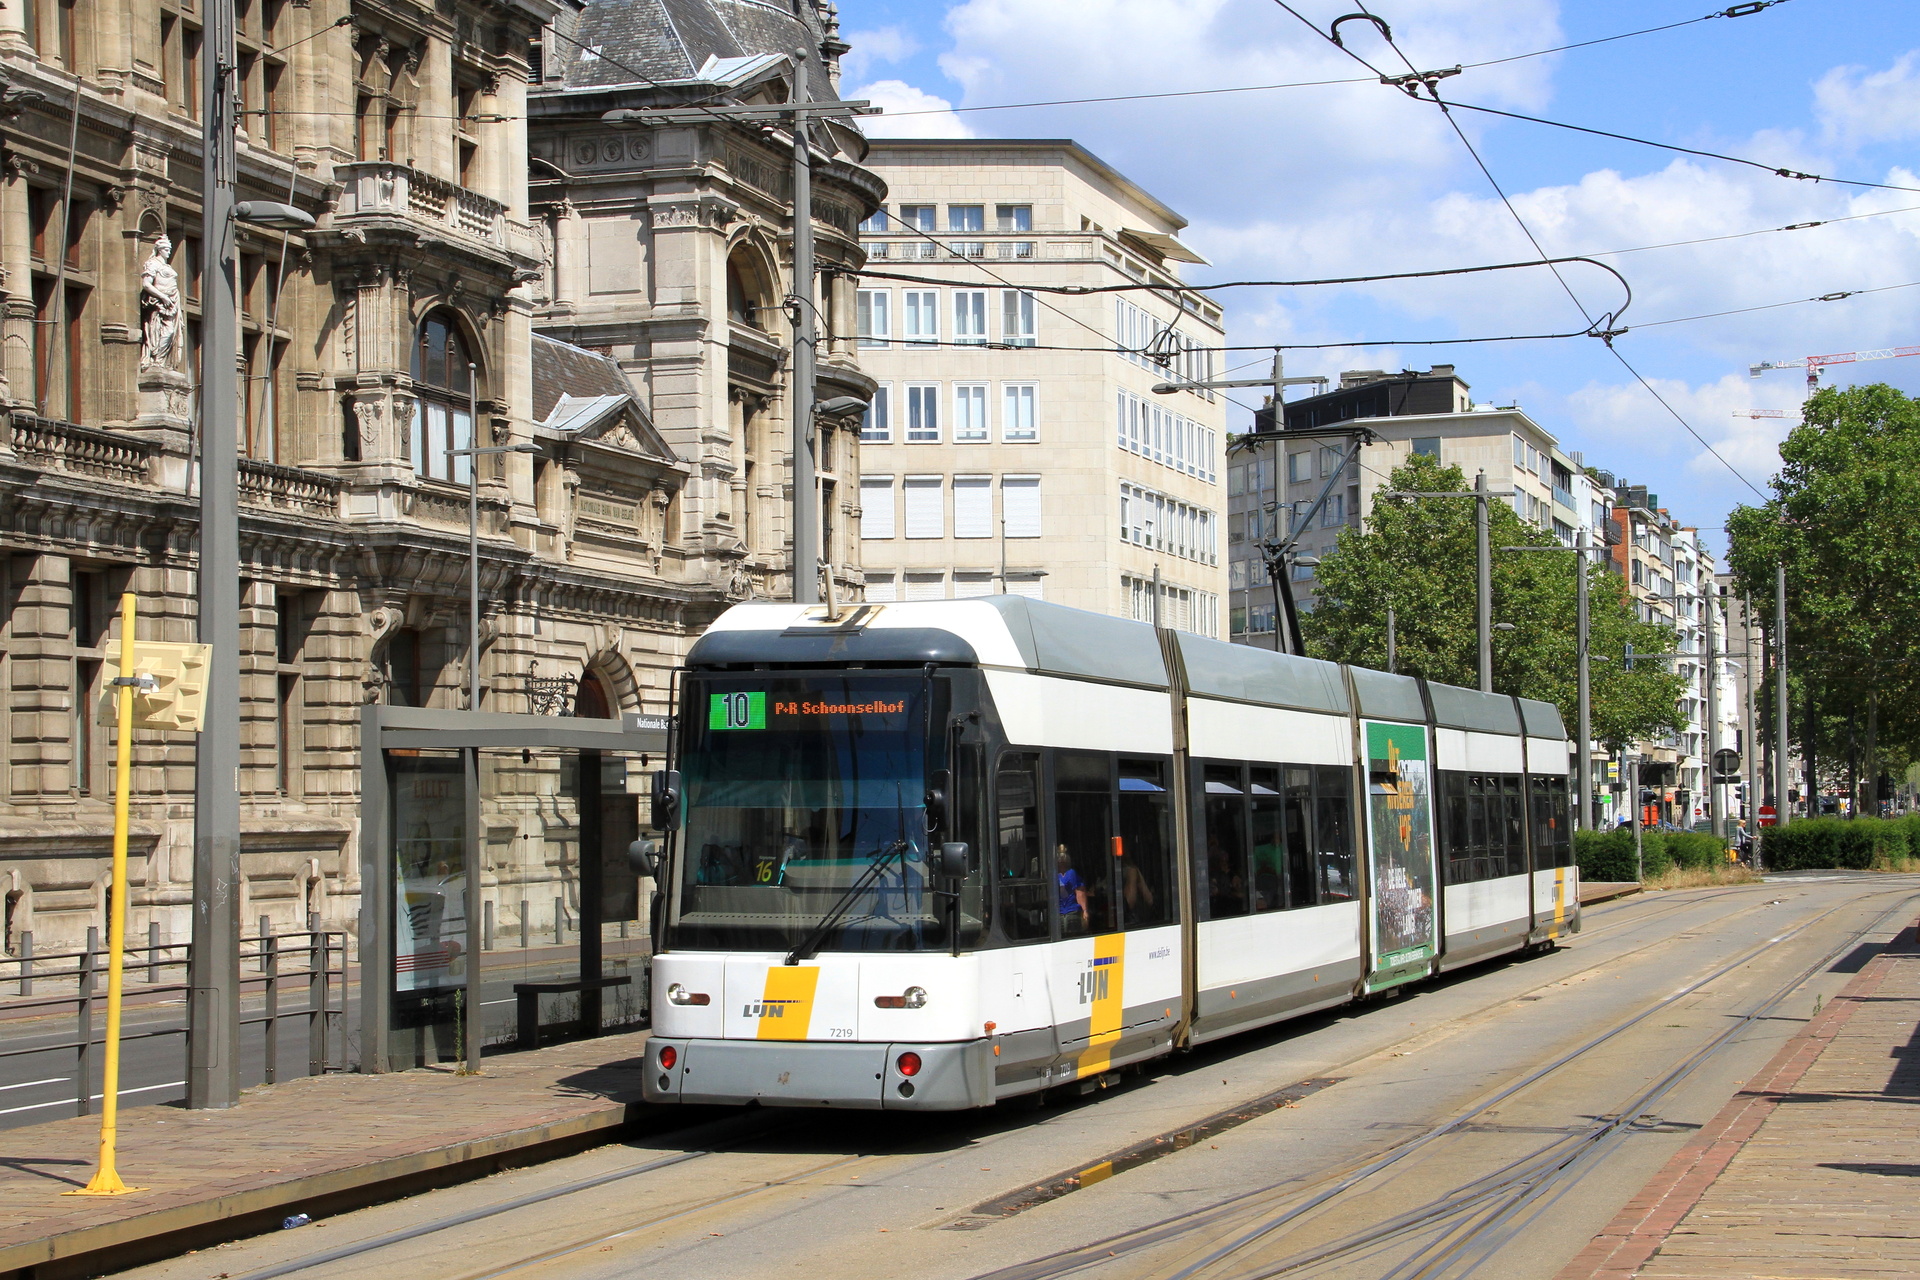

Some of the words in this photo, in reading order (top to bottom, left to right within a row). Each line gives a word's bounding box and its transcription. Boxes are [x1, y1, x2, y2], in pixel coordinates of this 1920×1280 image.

[723, 692, 750, 728] 10
[775, 702, 798, 715] P+R
[802, 700, 905, 715] Schoonselhof
[636, 717, 661, 730] Nationale
[756, 860, 773, 882] 16
[1087, 958, 1094, 969] DE
[1079, 968, 1109, 1005] LIJN
[742, 1004, 785, 1018] LIJN
[829, 1028, 853, 1038] 7219
